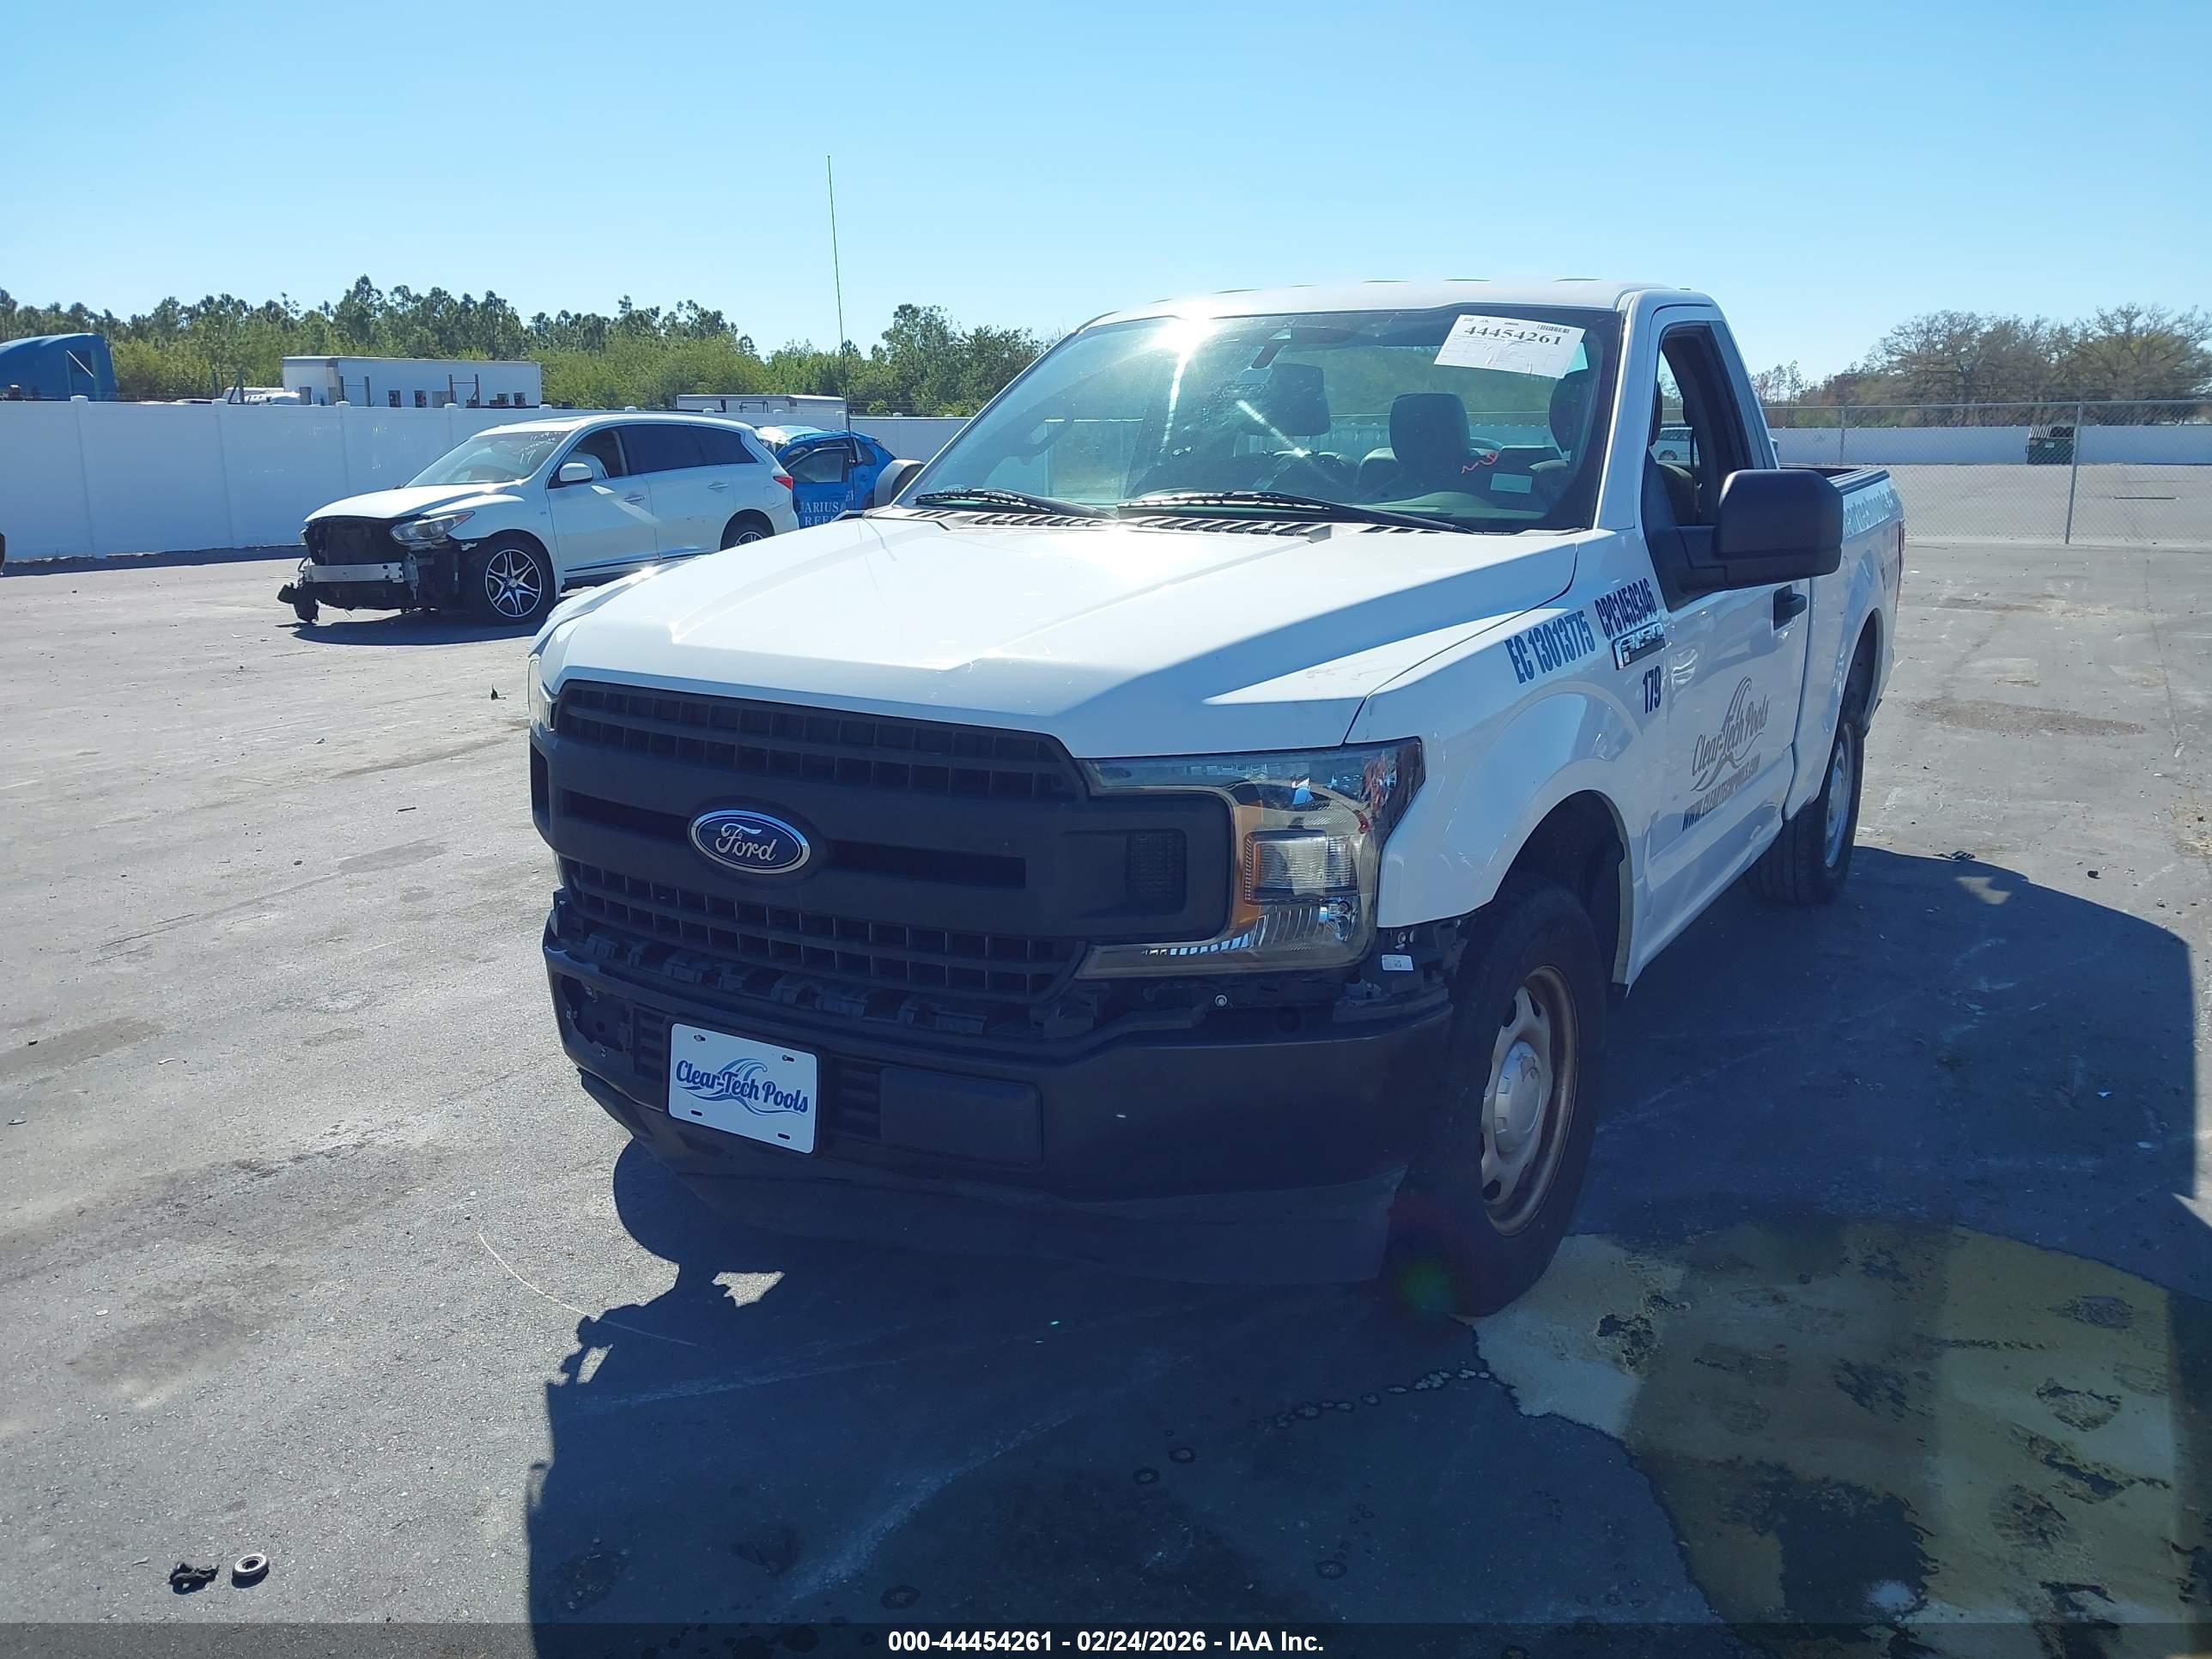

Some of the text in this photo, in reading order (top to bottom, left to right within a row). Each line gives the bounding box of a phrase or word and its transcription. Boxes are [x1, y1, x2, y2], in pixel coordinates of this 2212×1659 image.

[1463, 325, 1563, 345] 44454261
[1594, 577, 1657, 641] CPC1459346
[1504, 610, 1596, 684] EC 13013775
[1643, 665, 1662, 714] 179
[714, 823, 777, 861] Ford
[676, 1060, 809, 1114] Clear-Tech Pools
